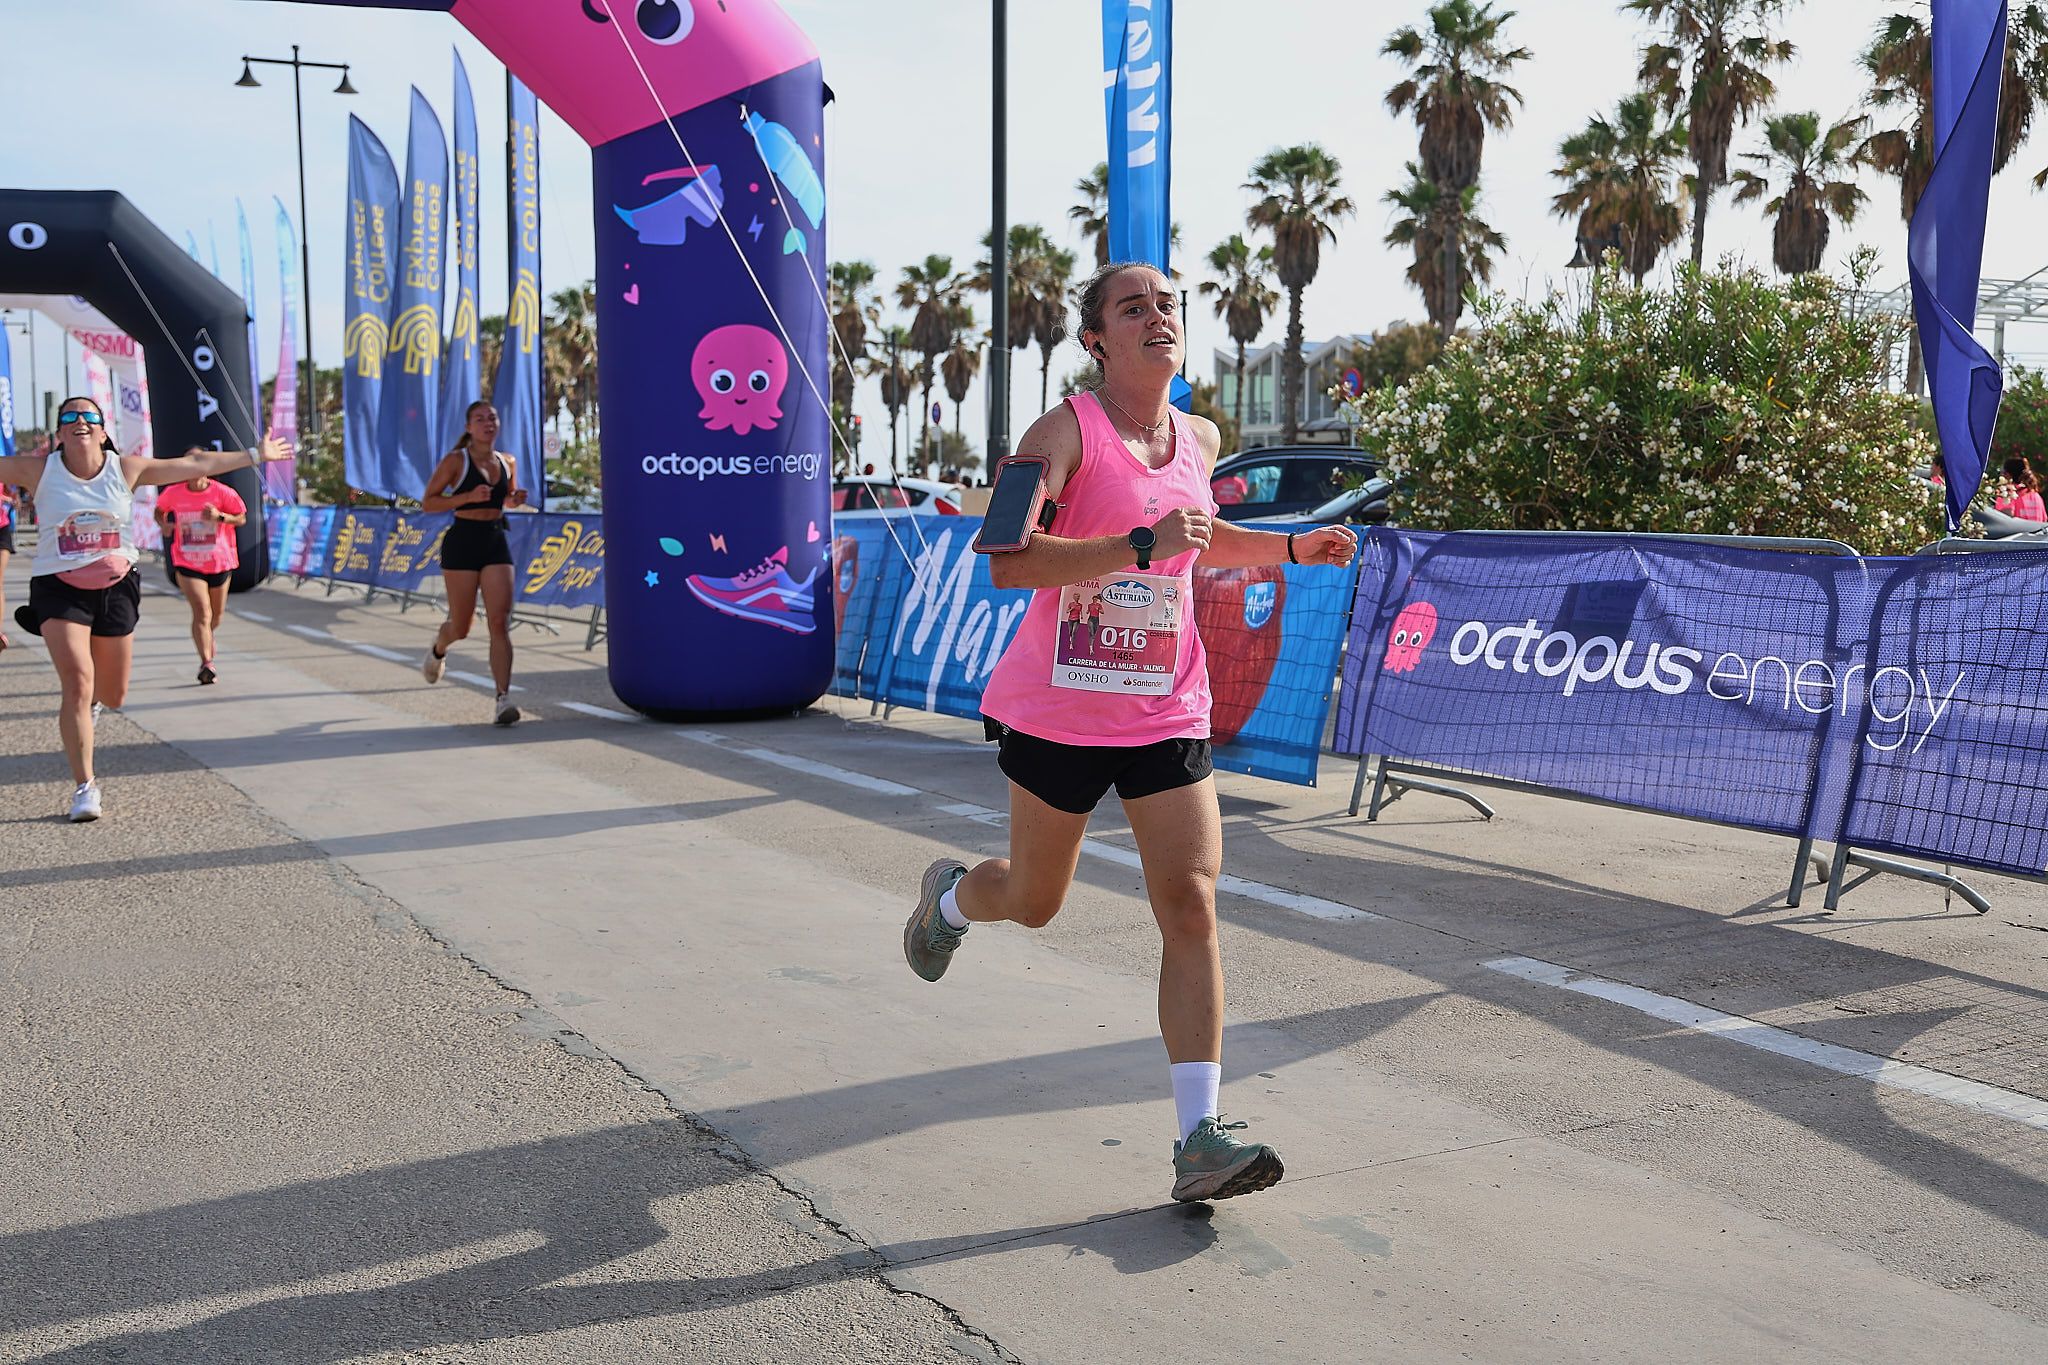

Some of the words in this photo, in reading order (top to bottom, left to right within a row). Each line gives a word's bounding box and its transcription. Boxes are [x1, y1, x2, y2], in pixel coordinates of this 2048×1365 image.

[641, 452, 751, 481] octopus
[754, 453, 822, 481] energy
[1100, 627, 1148, 649] 016
[1112, 651, 1134, 661] 1465
[1068, 657, 1098, 667] CARRERA
[1108, 661, 1117, 669] LA
[1117, 662, 1138, 671] MUJER
[1143, 664, 1166, 672] VALENCIA
[1068, 671, 1109, 684] OYSHO
[1132, 679, 1164, 688] Santander
[1449, 618, 1703, 697] octopus
[1706, 651, 1966, 753] energy
